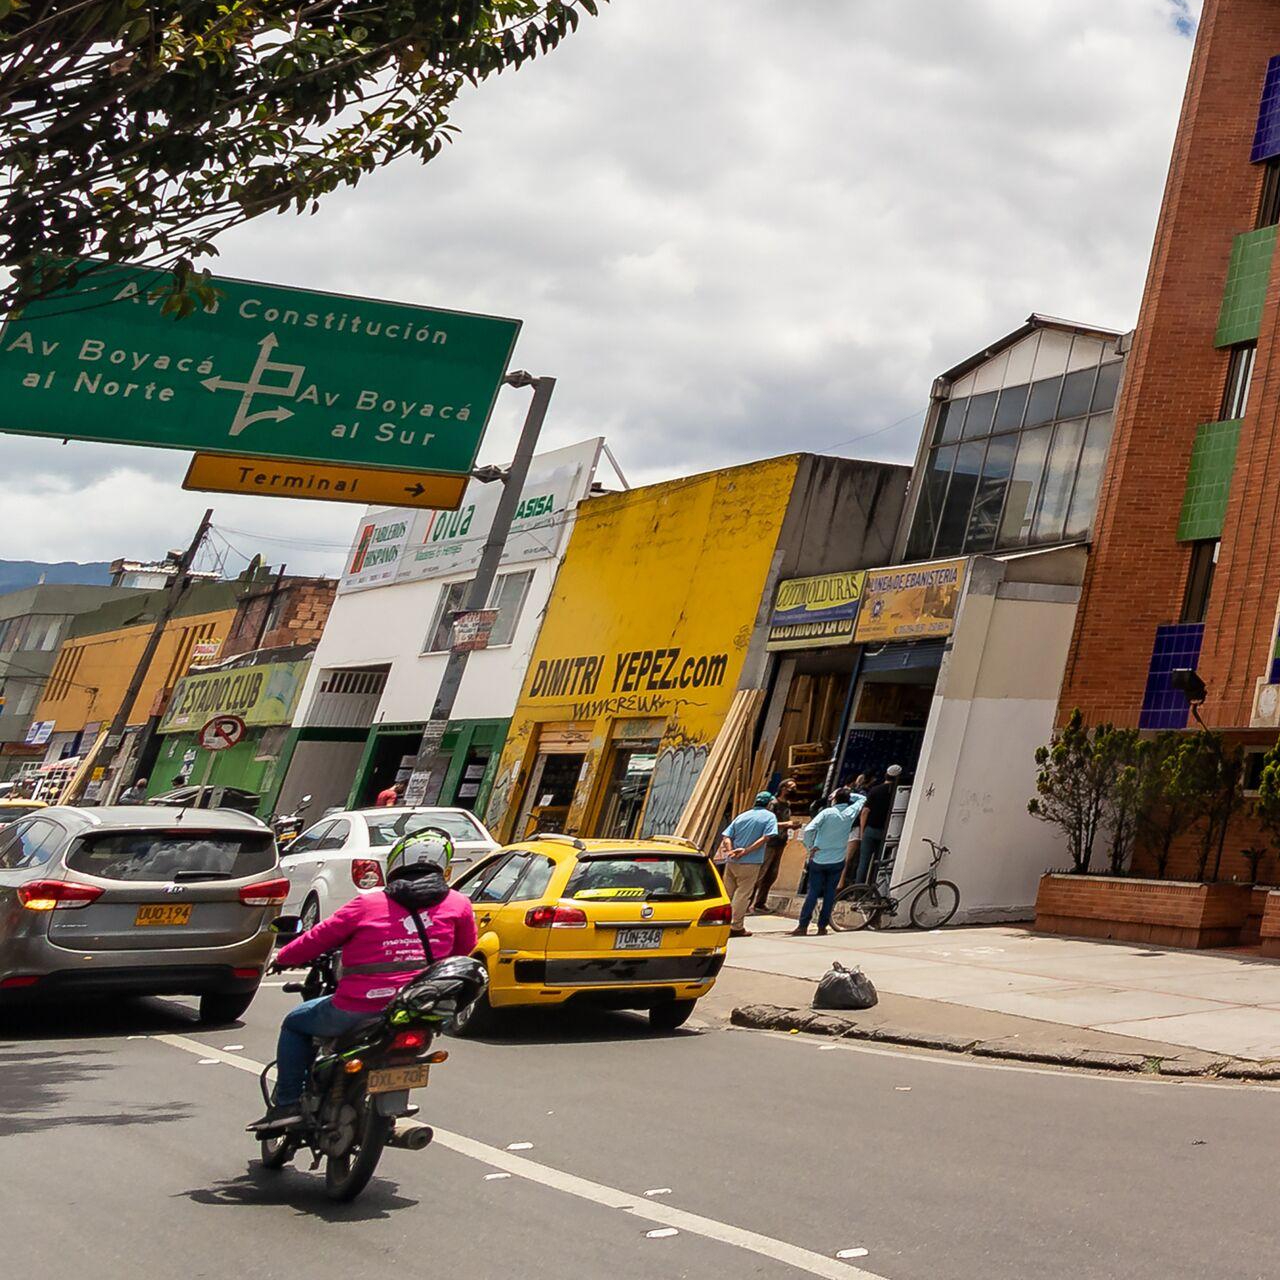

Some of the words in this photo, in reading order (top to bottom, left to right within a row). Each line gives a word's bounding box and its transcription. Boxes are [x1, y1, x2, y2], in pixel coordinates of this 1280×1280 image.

[239, 299, 447, 344] Constitución
[6, 331, 59, 356] Av
[78, 339, 214, 374] Boyacá
[22, 370, 55, 389] al
[73, 371, 175, 402] Norte
[296, 384, 340, 406] Av
[356, 390, 471, 421] Boyacá
[331, 422, 359, 438] al
[375, 422, 435, 446] Sur
[239, 467, 359, 492] Terminal
[514, 495, 554, 520] ASISA
[893, 573, 905, 590] DE
[905, 568, 958, 588] EBANISTERIA
[529, 655, 605, 697] DIMITRI
[611, 648, 728, 693] YEPEZ.com
[179, 675, 231, 714] ESTADIO
[226, 672, 263, 710] CLUB
